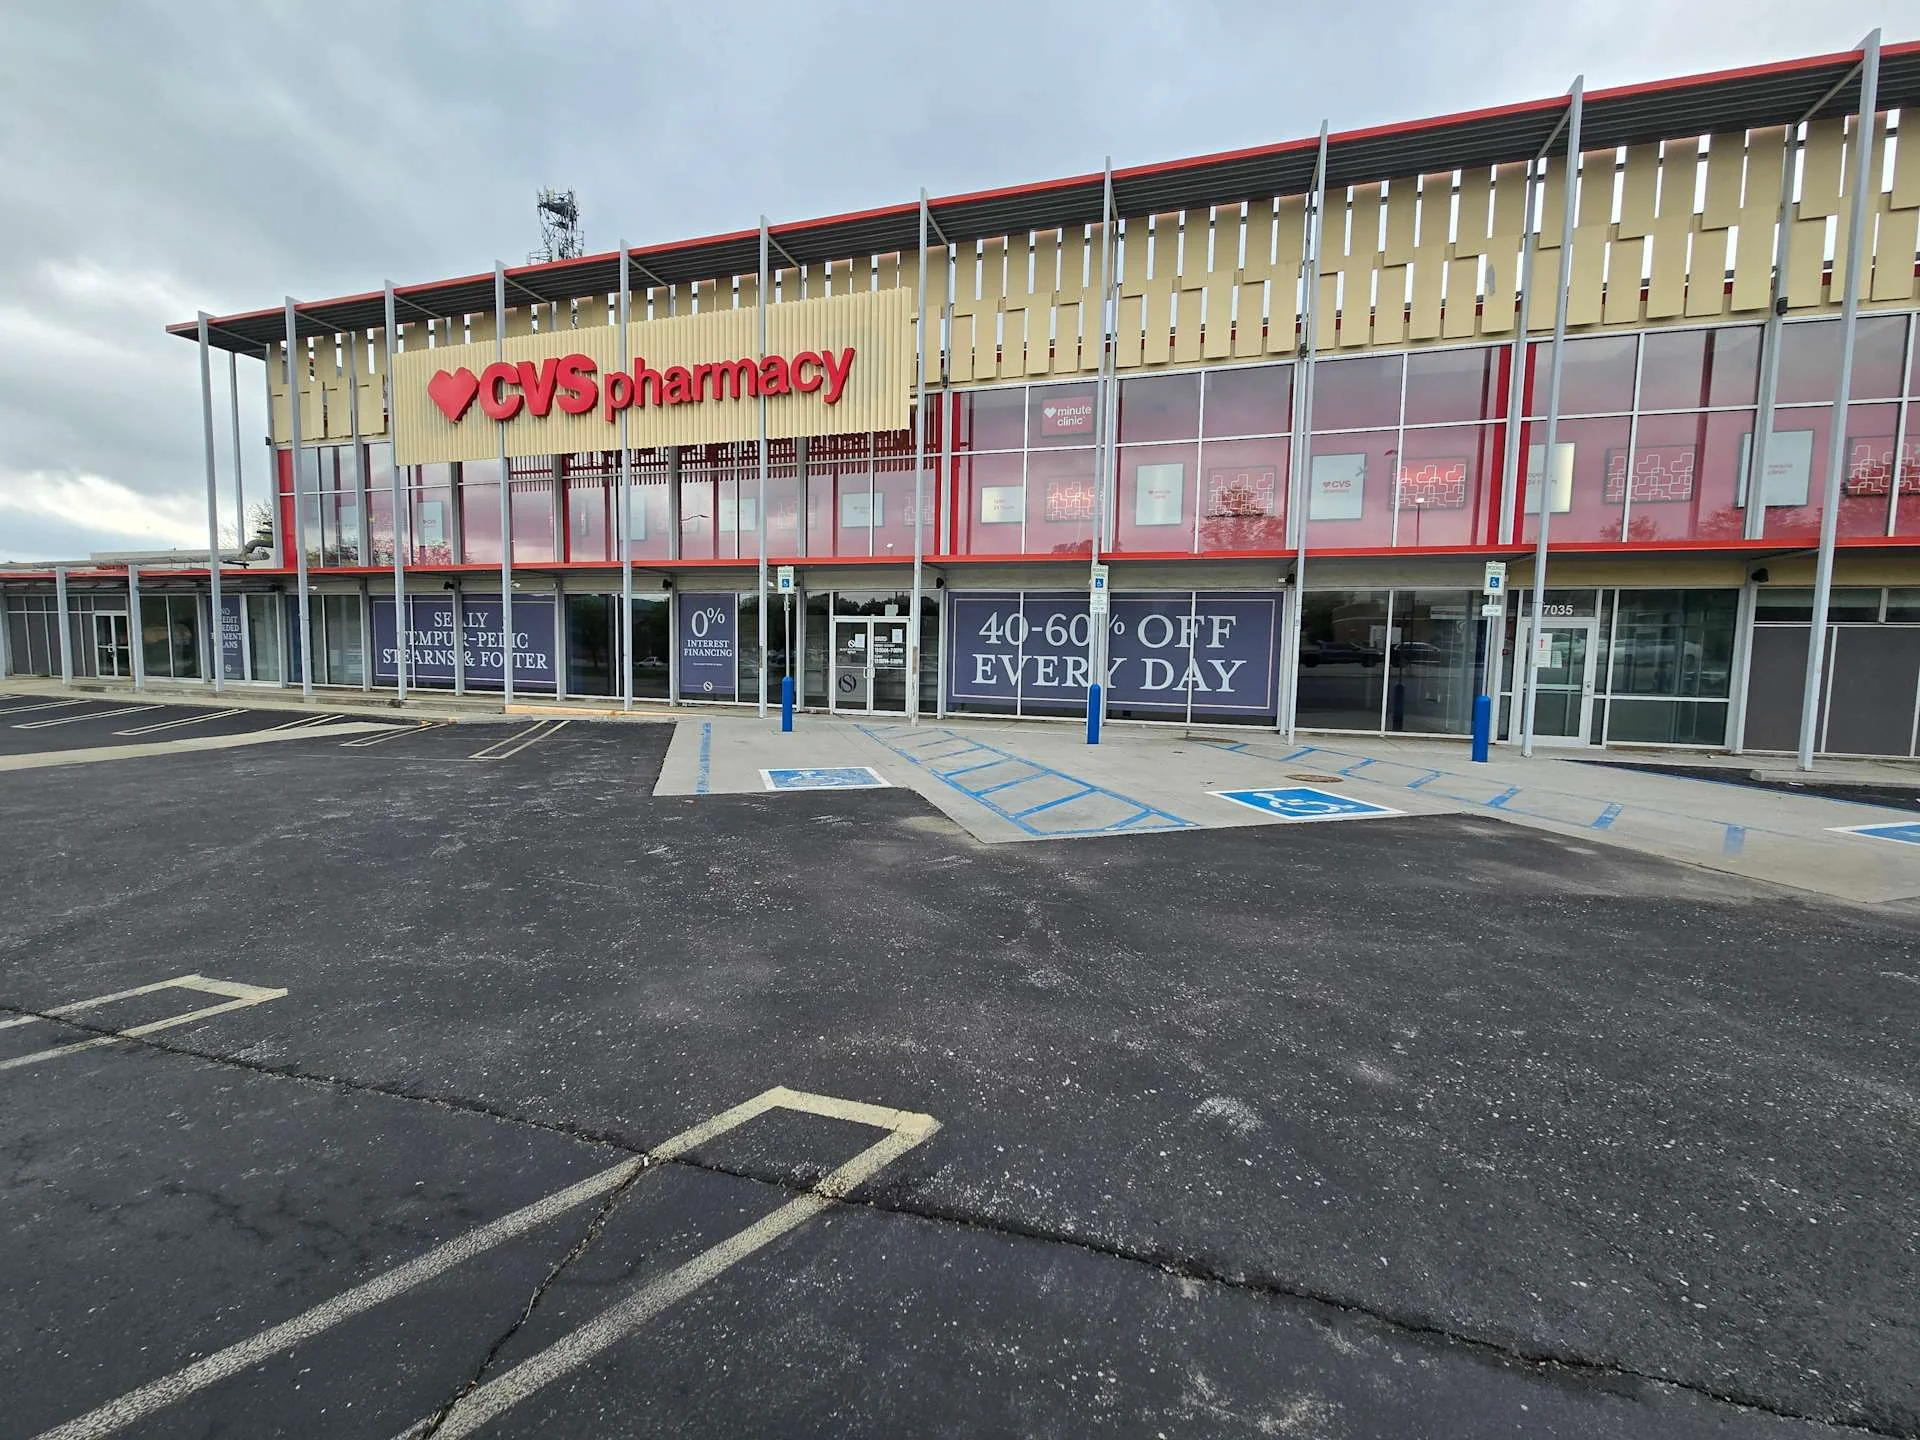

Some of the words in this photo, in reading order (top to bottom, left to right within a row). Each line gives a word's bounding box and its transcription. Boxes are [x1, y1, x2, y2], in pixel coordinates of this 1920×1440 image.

[479, 354, 599, 420] CVS
[604, 347, 857, 423] pharmacy
[1057, 405, 1091, 416] minute
[1057, 416, 1083, 426] clinic
[1331, 480, 1352, 488] CVS
[1543, 604, 1574, 615] 7035
[434, 611, 489, 628] SELY
[691, 607, 726, 637] 0%
[1137, 614, 1237, 649] OFF
[687, 640, 730, 648] INTEREST
[464, 651, 476, 667] &
[480, 651, 549, 669] FOTER
[683, 649, 732, 657] FINANCING
[971, 653, 1128, 689] EVERY
[1140, 657, 1247, 692] DAY
